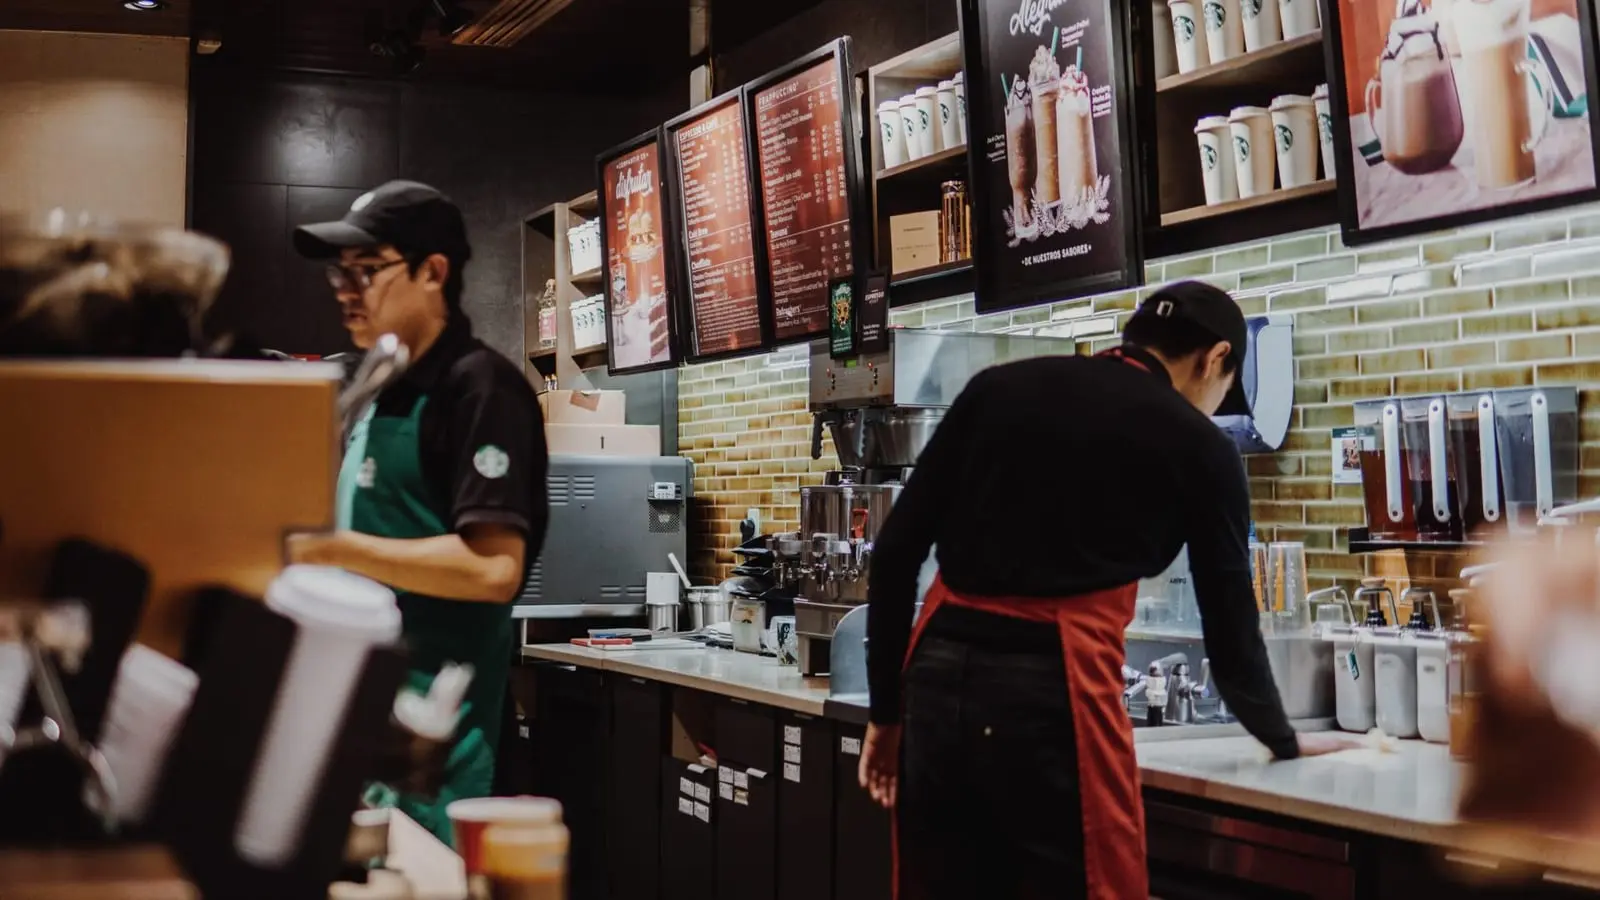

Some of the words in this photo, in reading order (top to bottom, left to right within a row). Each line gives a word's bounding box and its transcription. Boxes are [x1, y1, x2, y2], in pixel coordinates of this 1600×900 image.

[1025, 256, 1032, 266] DE
[1033, 249, 1061, 264] NUESTROS
[1062, 243, 1088, 259] SABORES
